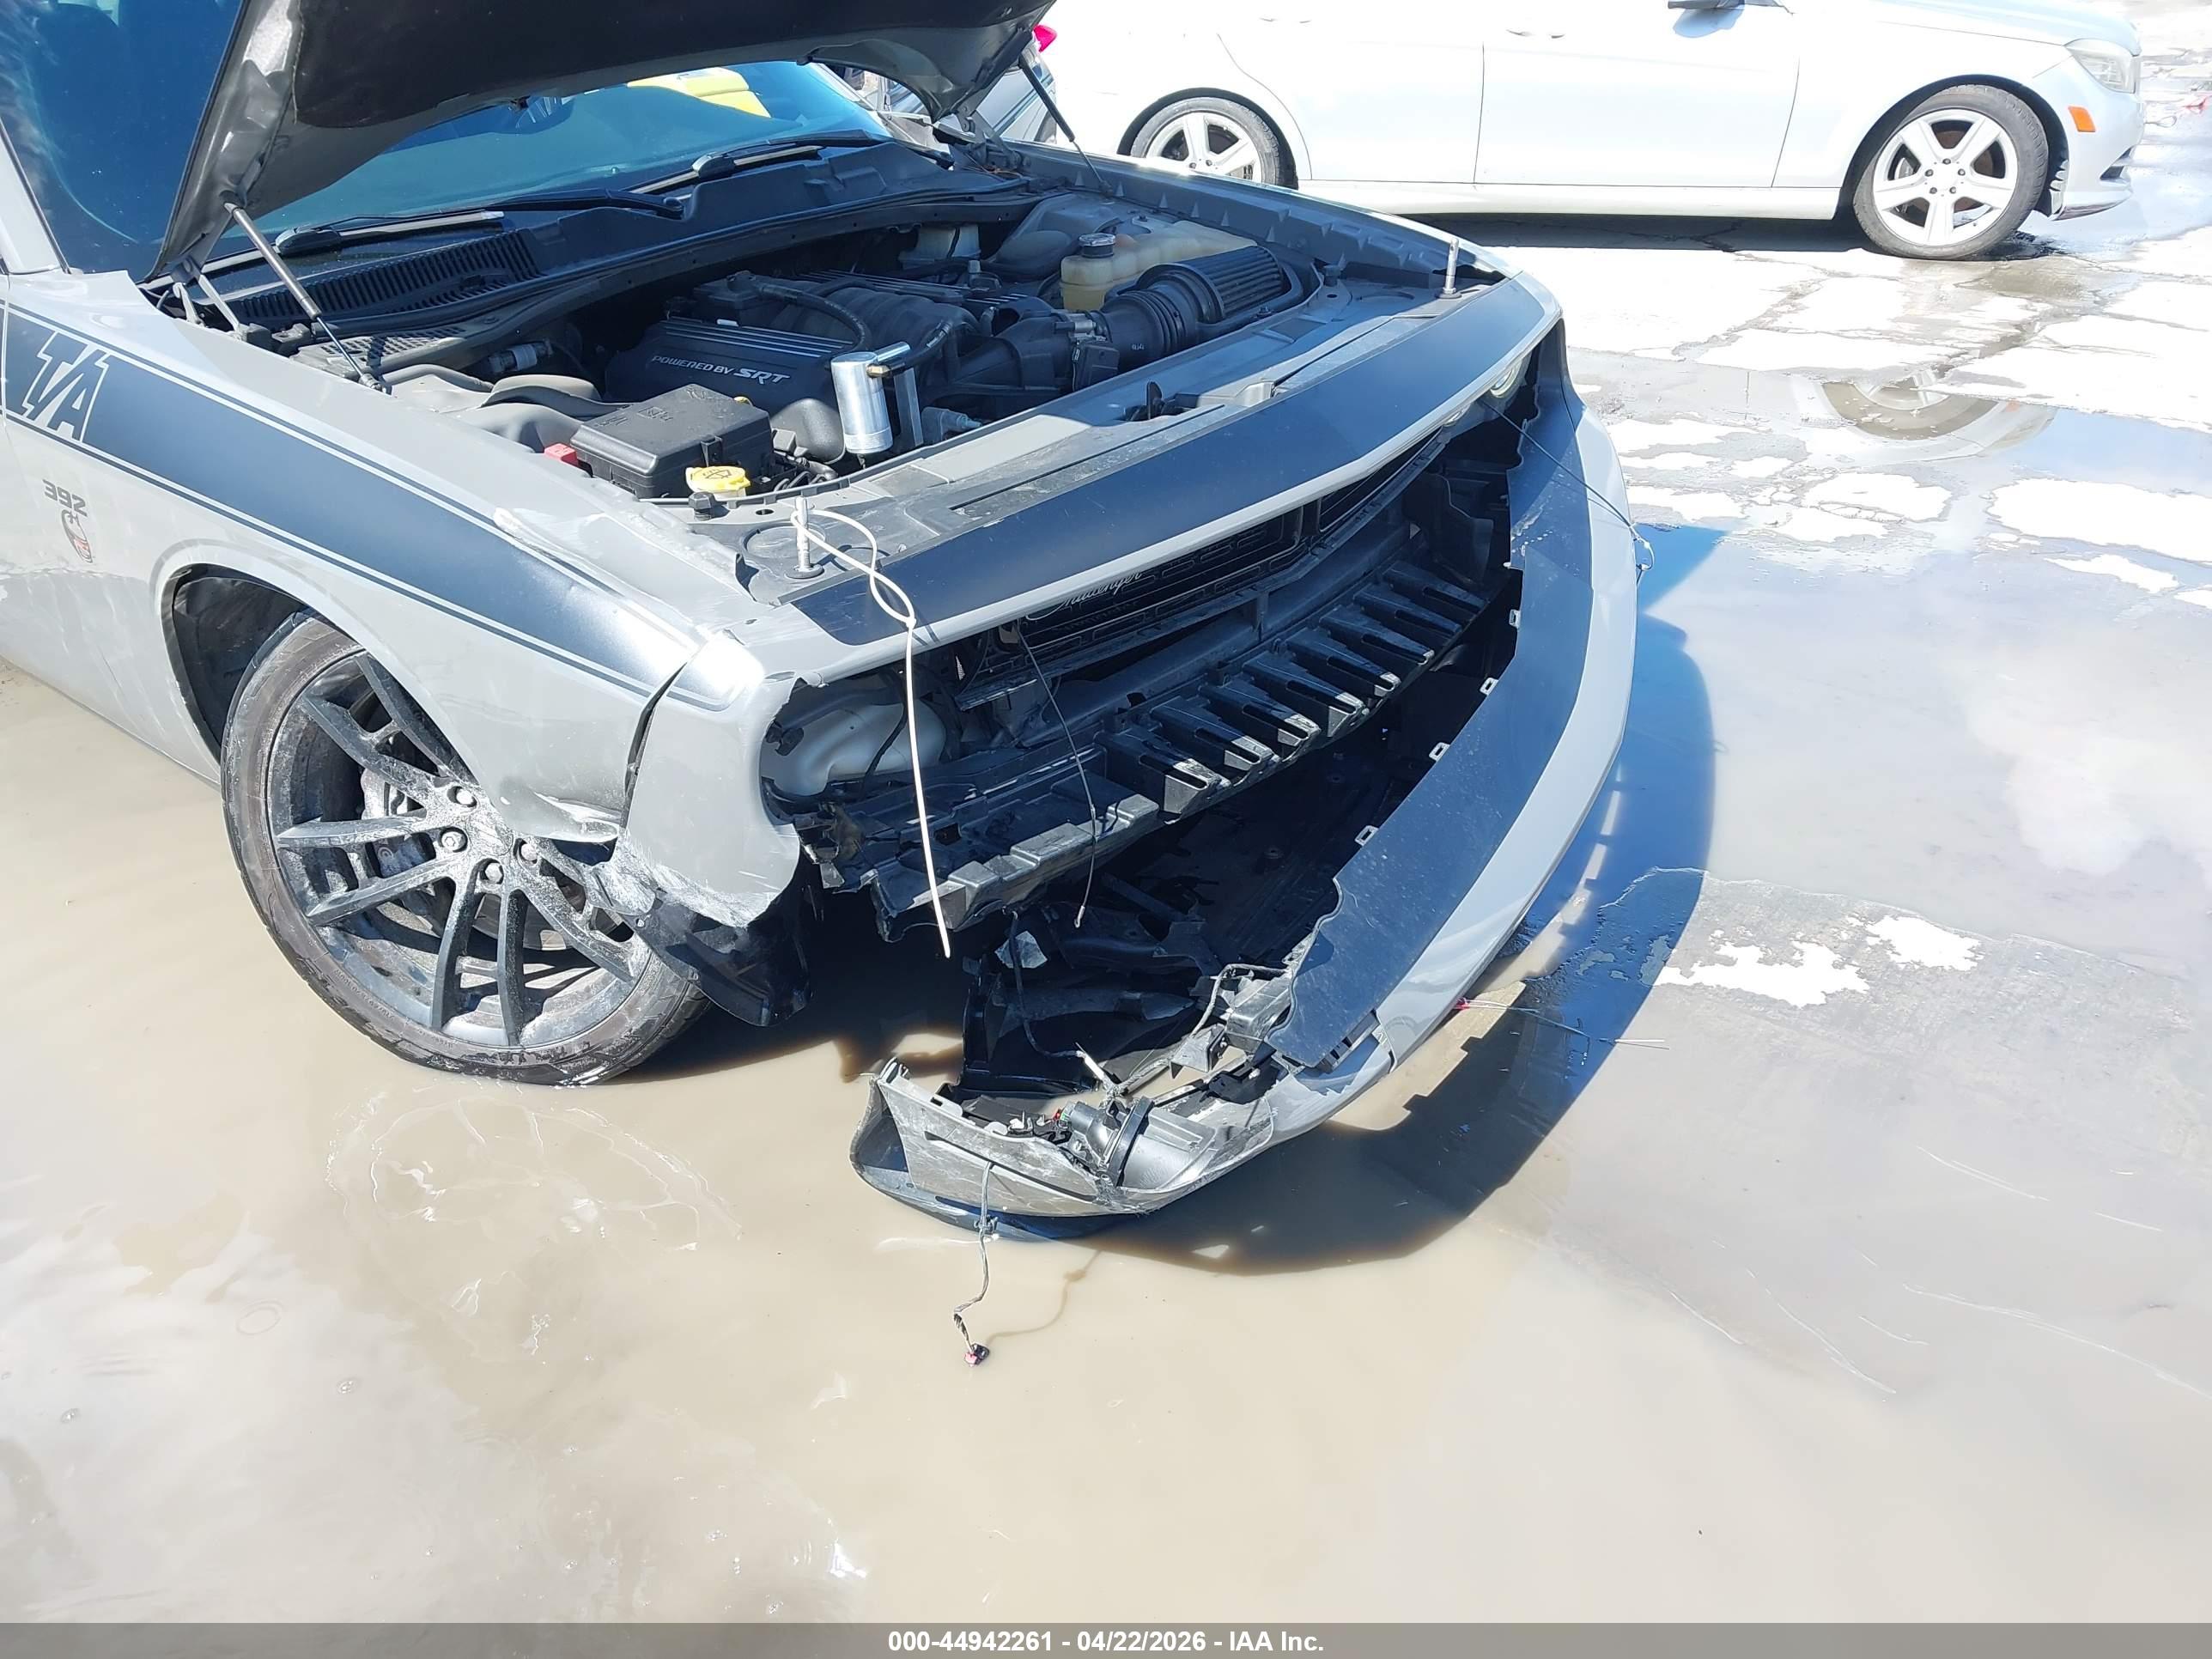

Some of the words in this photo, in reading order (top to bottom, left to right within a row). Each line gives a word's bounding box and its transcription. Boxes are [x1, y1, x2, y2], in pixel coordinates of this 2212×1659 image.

[24, 330, 106, 442] T/A
[651, 356, 713, 371] POWERED
[714, 366, 735, 374] BY
[733, 368, 791, 385] SRT
[43, 479, 88, 517] 392
